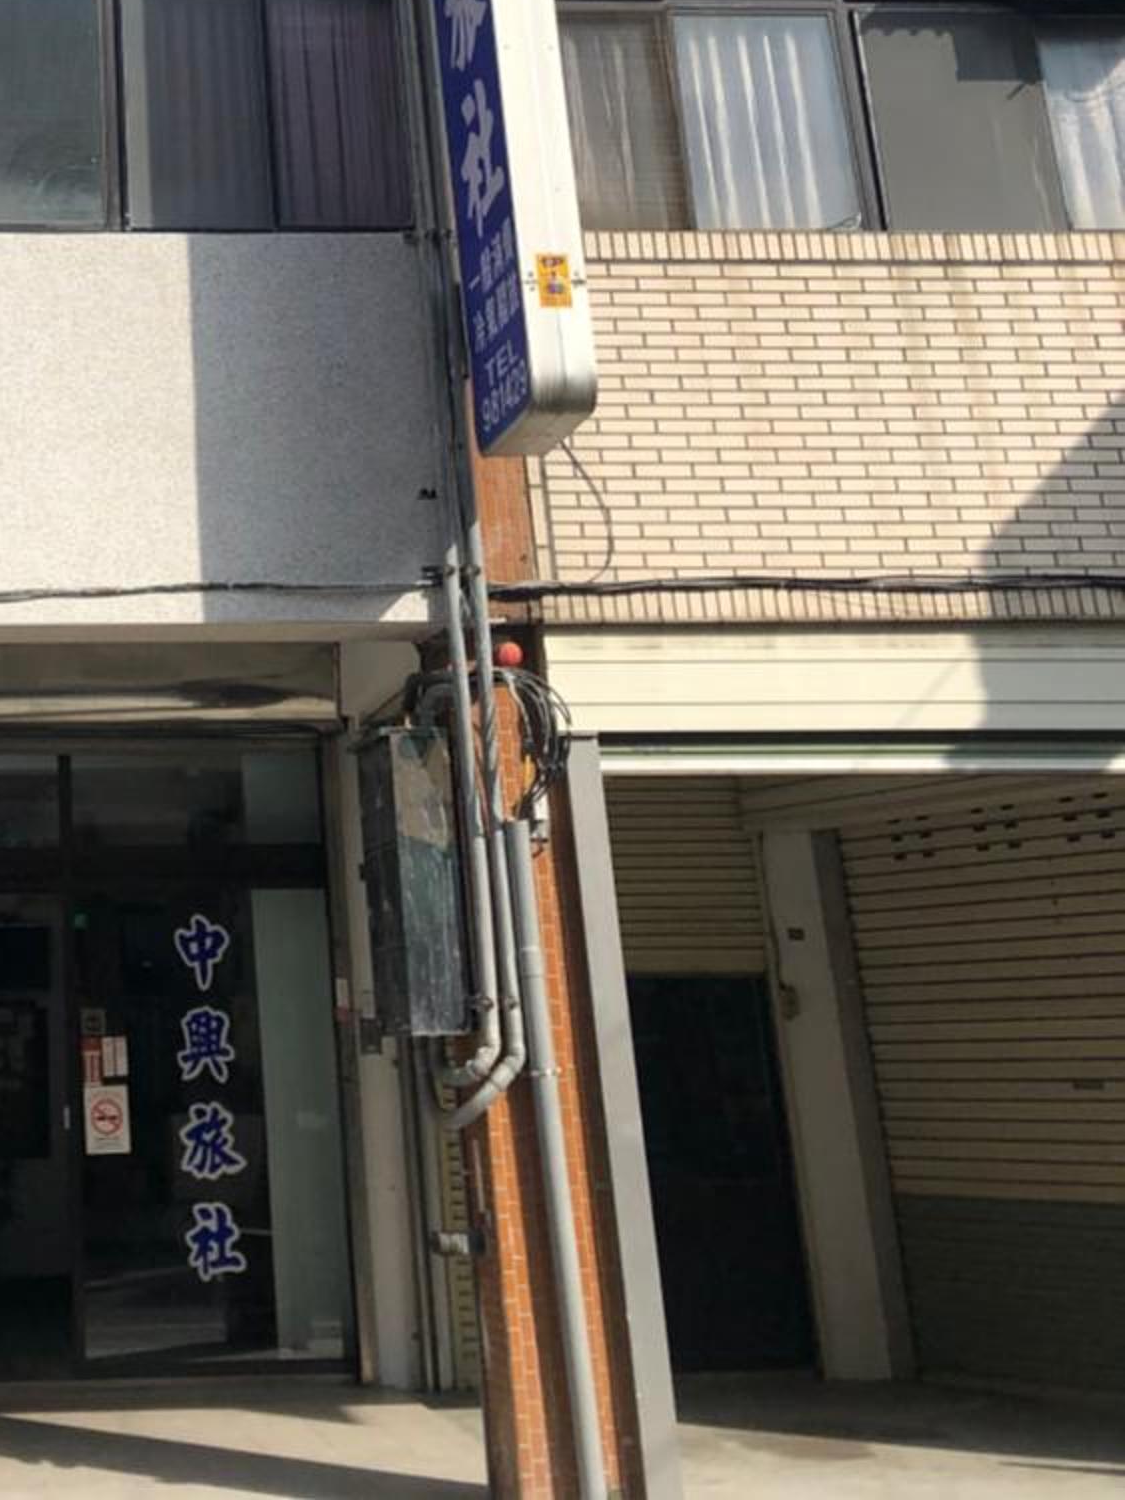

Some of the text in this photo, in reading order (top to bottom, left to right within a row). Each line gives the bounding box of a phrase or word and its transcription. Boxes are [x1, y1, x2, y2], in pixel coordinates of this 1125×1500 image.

[484, 339, 518, 388] TEL
[175, 914, 248, 1282] 中興旅社
